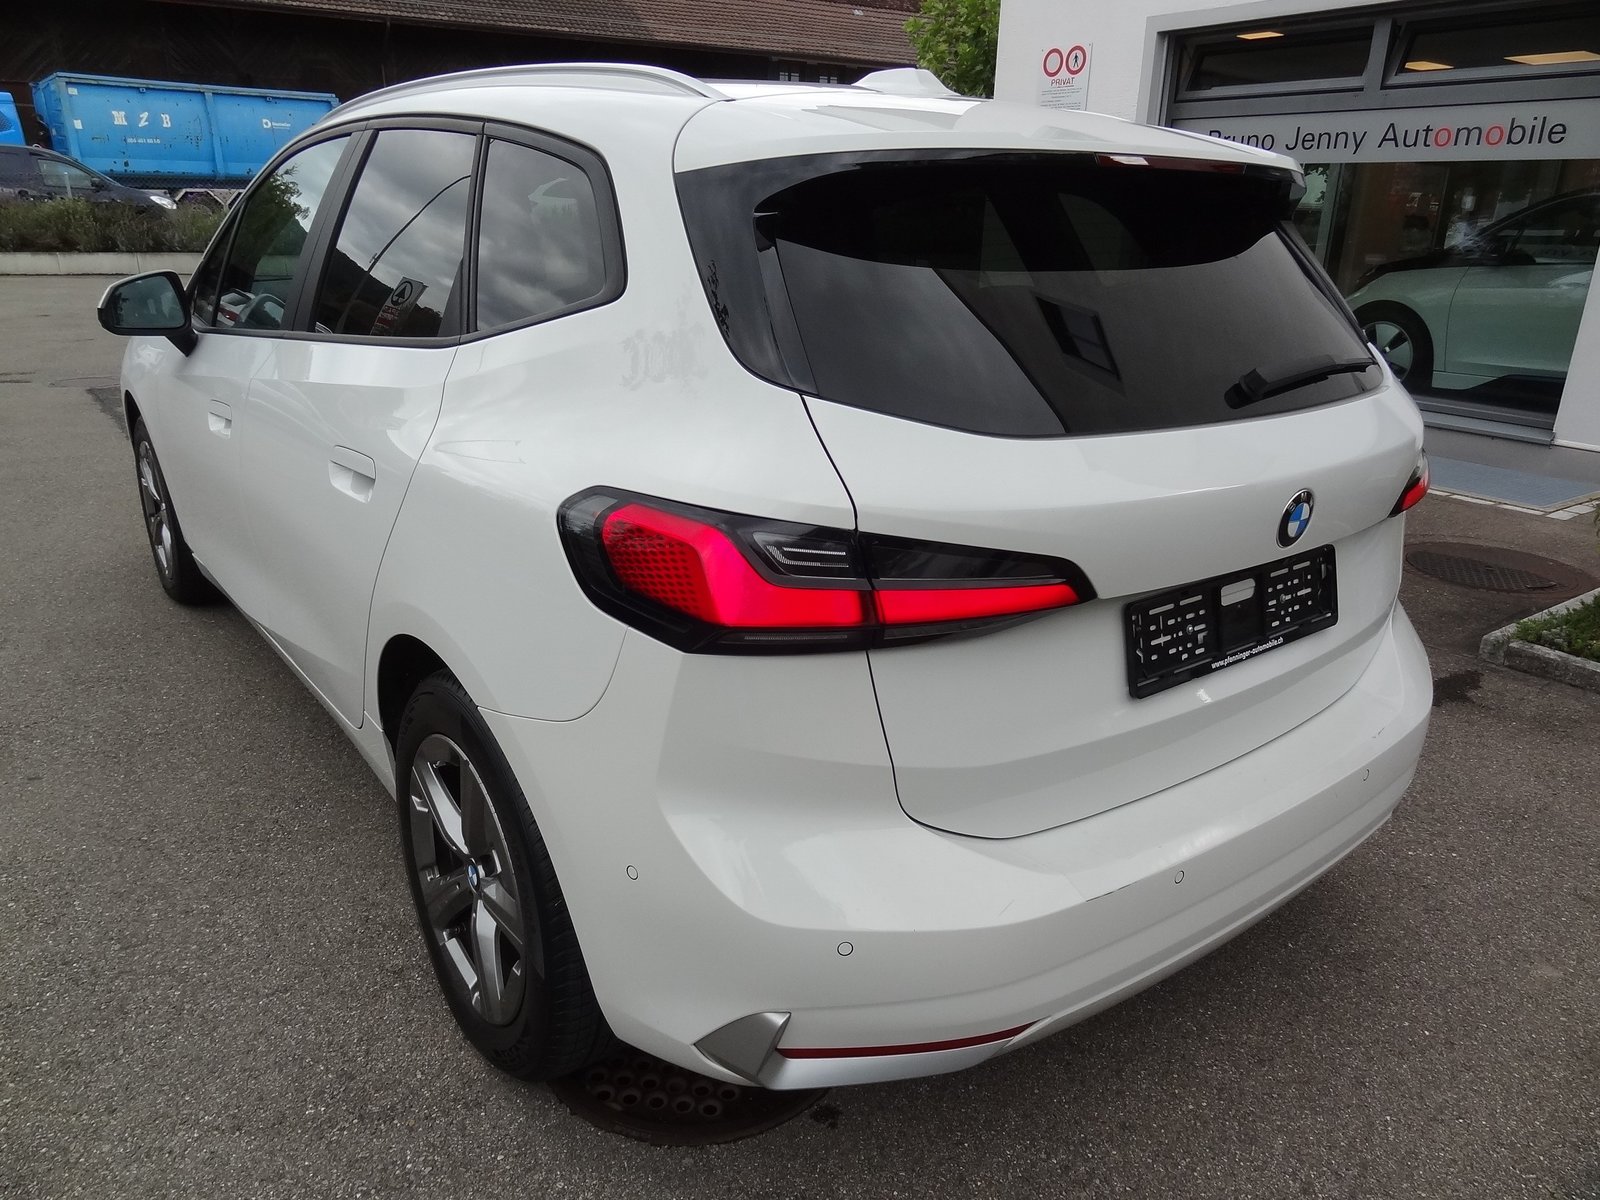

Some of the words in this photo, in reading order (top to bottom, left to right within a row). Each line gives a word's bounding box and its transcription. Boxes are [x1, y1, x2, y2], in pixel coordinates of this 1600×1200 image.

[1050, 77, 1075, 86] PRIVAT
[1285, 126, 1367, 155] Jenny
[1377, 115, 1567, 149] Automobile
